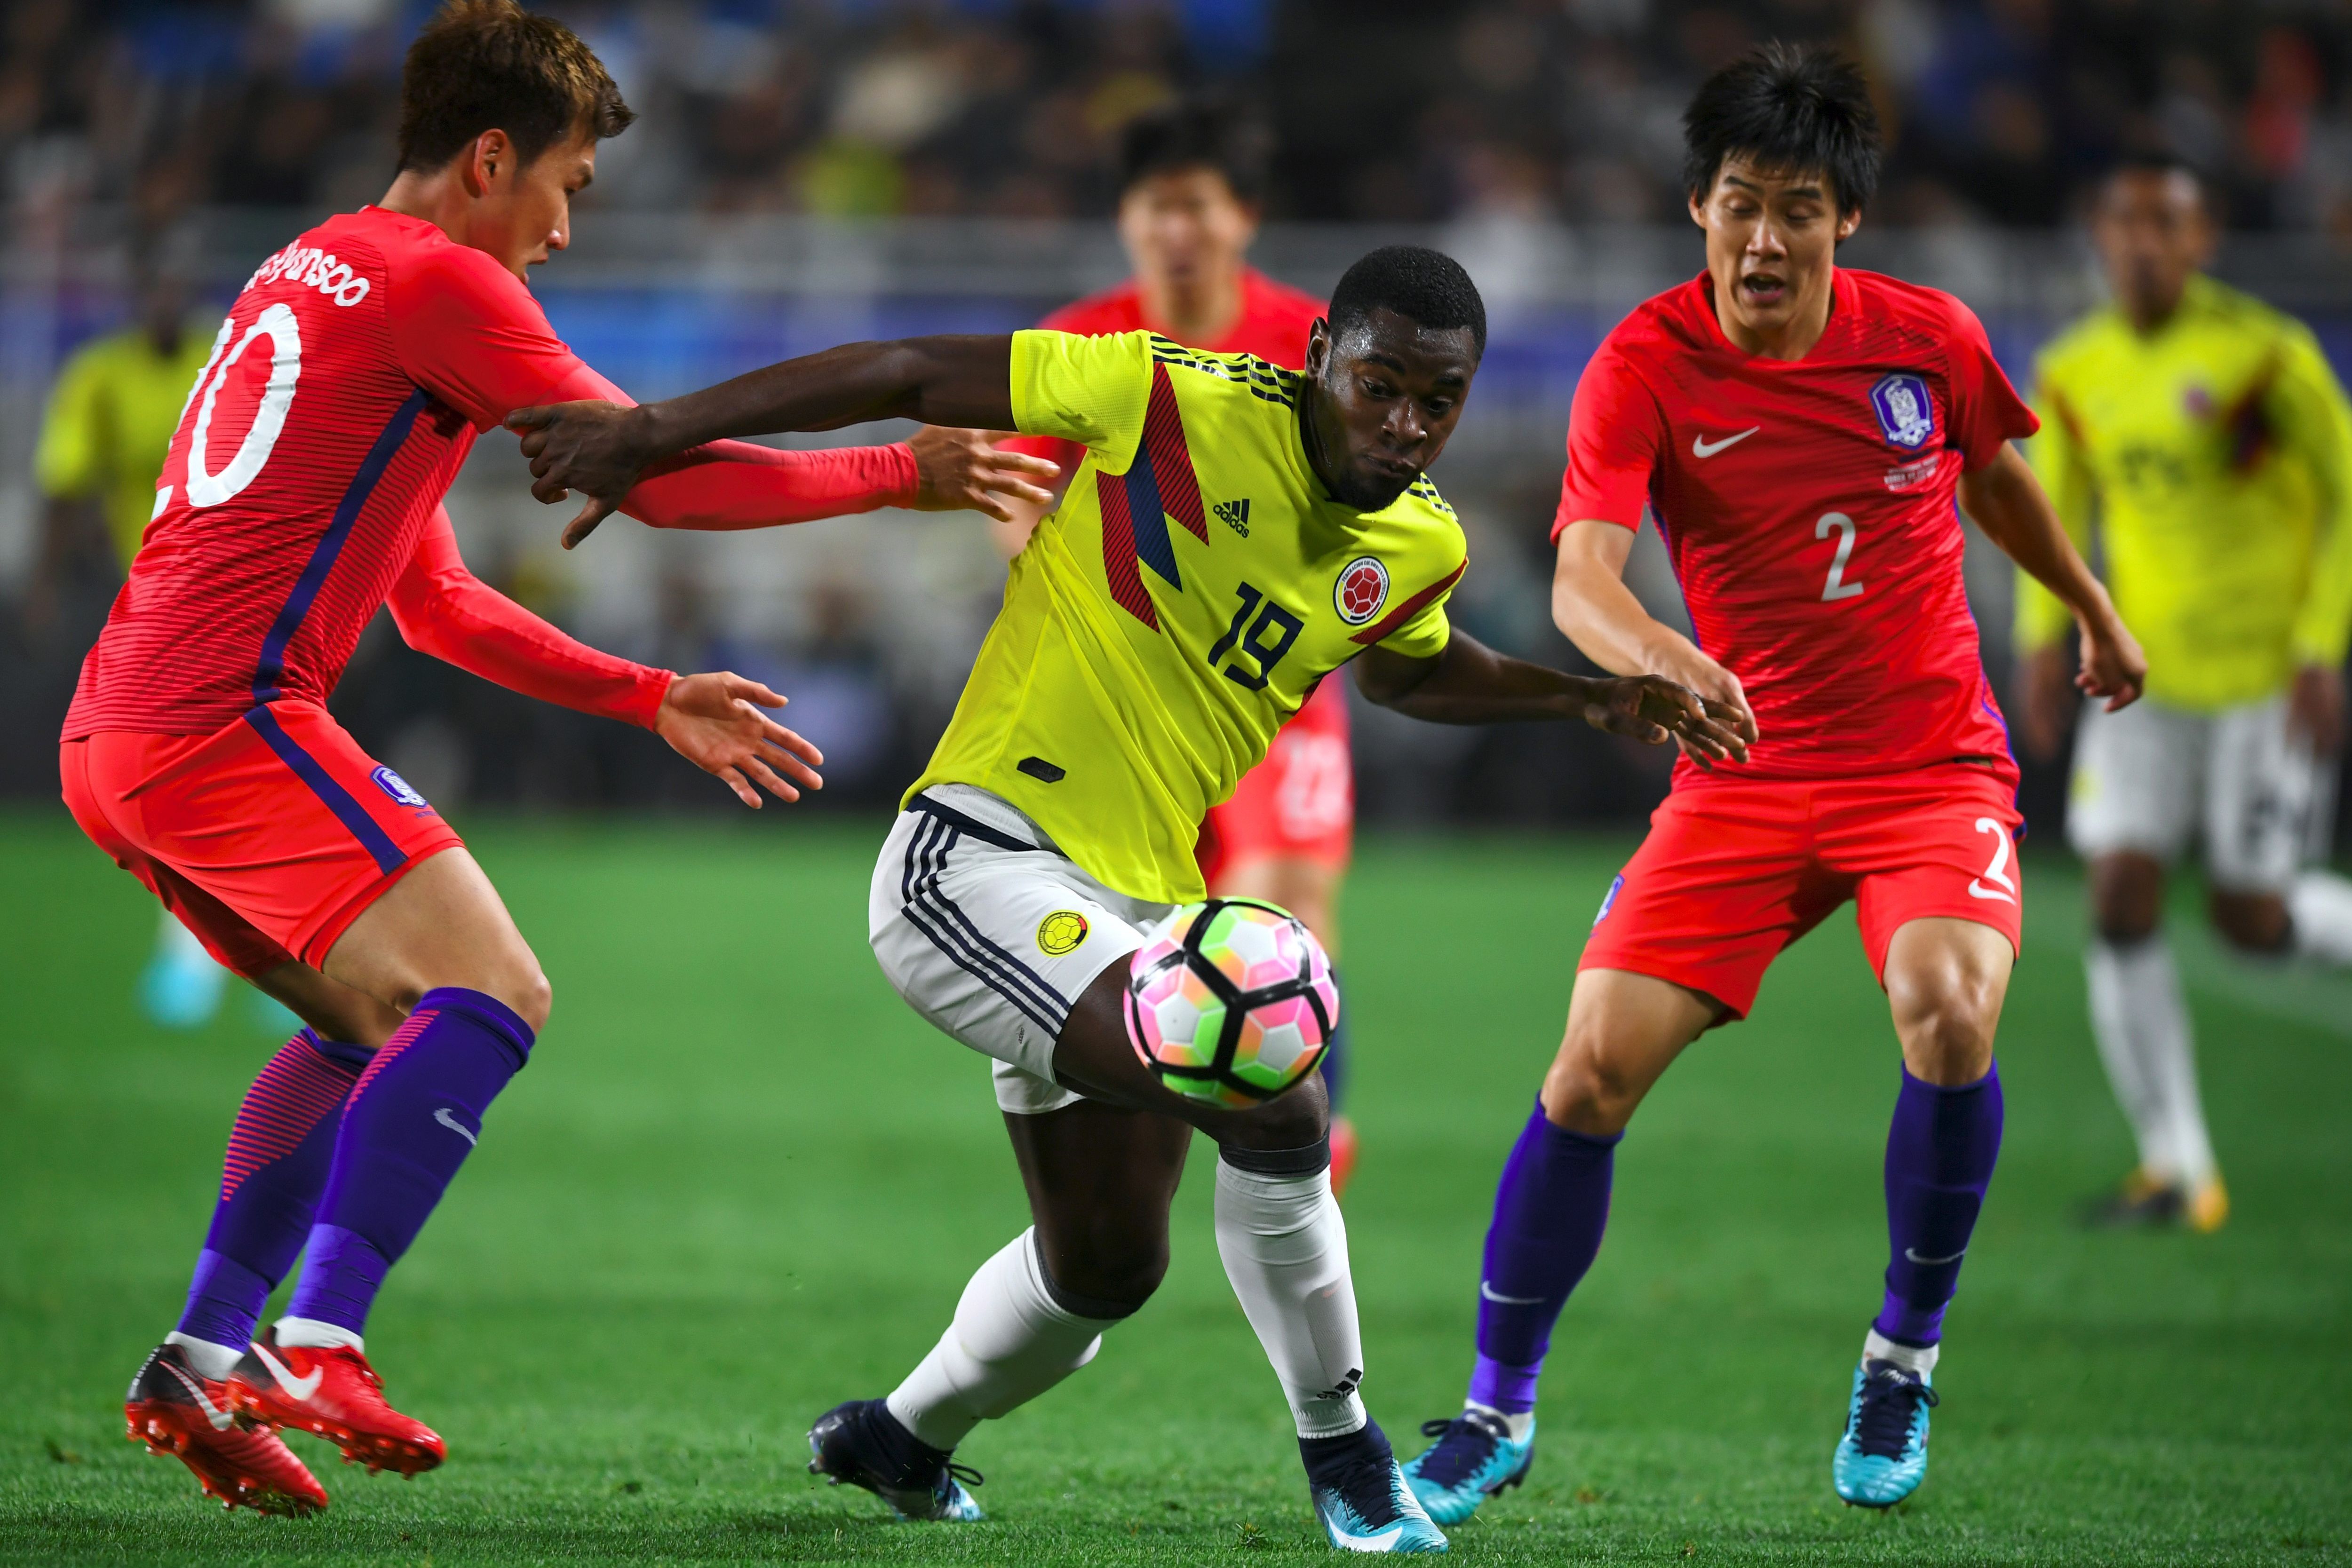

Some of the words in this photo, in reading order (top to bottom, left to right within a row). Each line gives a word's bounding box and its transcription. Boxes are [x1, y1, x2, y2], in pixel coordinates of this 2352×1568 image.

[1213, 504, 1250, 539] adidas
[1814, 511, 1865, 602] 2
[1207, 580, 1305, 692] 19
[1975, 817, 2016, 895] 2
